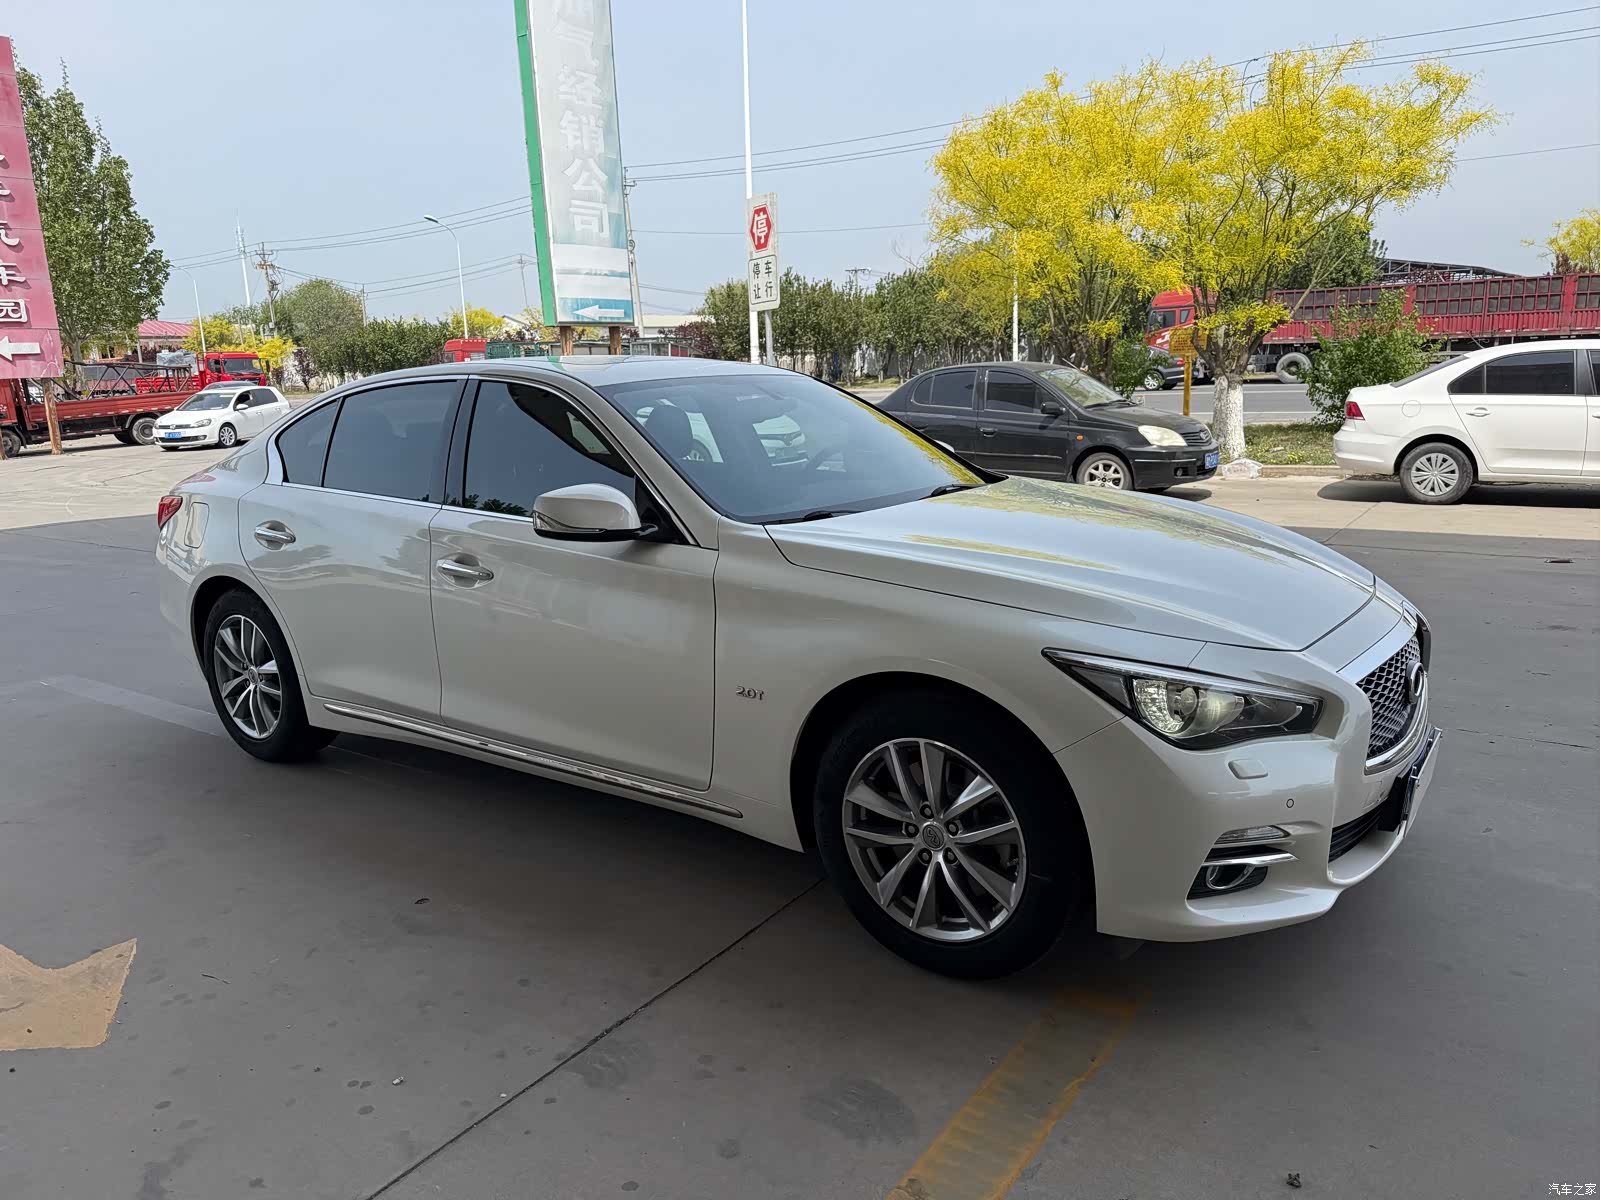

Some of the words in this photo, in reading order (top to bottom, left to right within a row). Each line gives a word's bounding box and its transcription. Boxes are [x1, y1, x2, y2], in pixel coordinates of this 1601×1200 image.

[753, 211, 768, 246] 停
[752, 260, 773, 279] 停车
[753, 281, 774, 299] 让行
[736, 685, 765, 701] 2.0T
